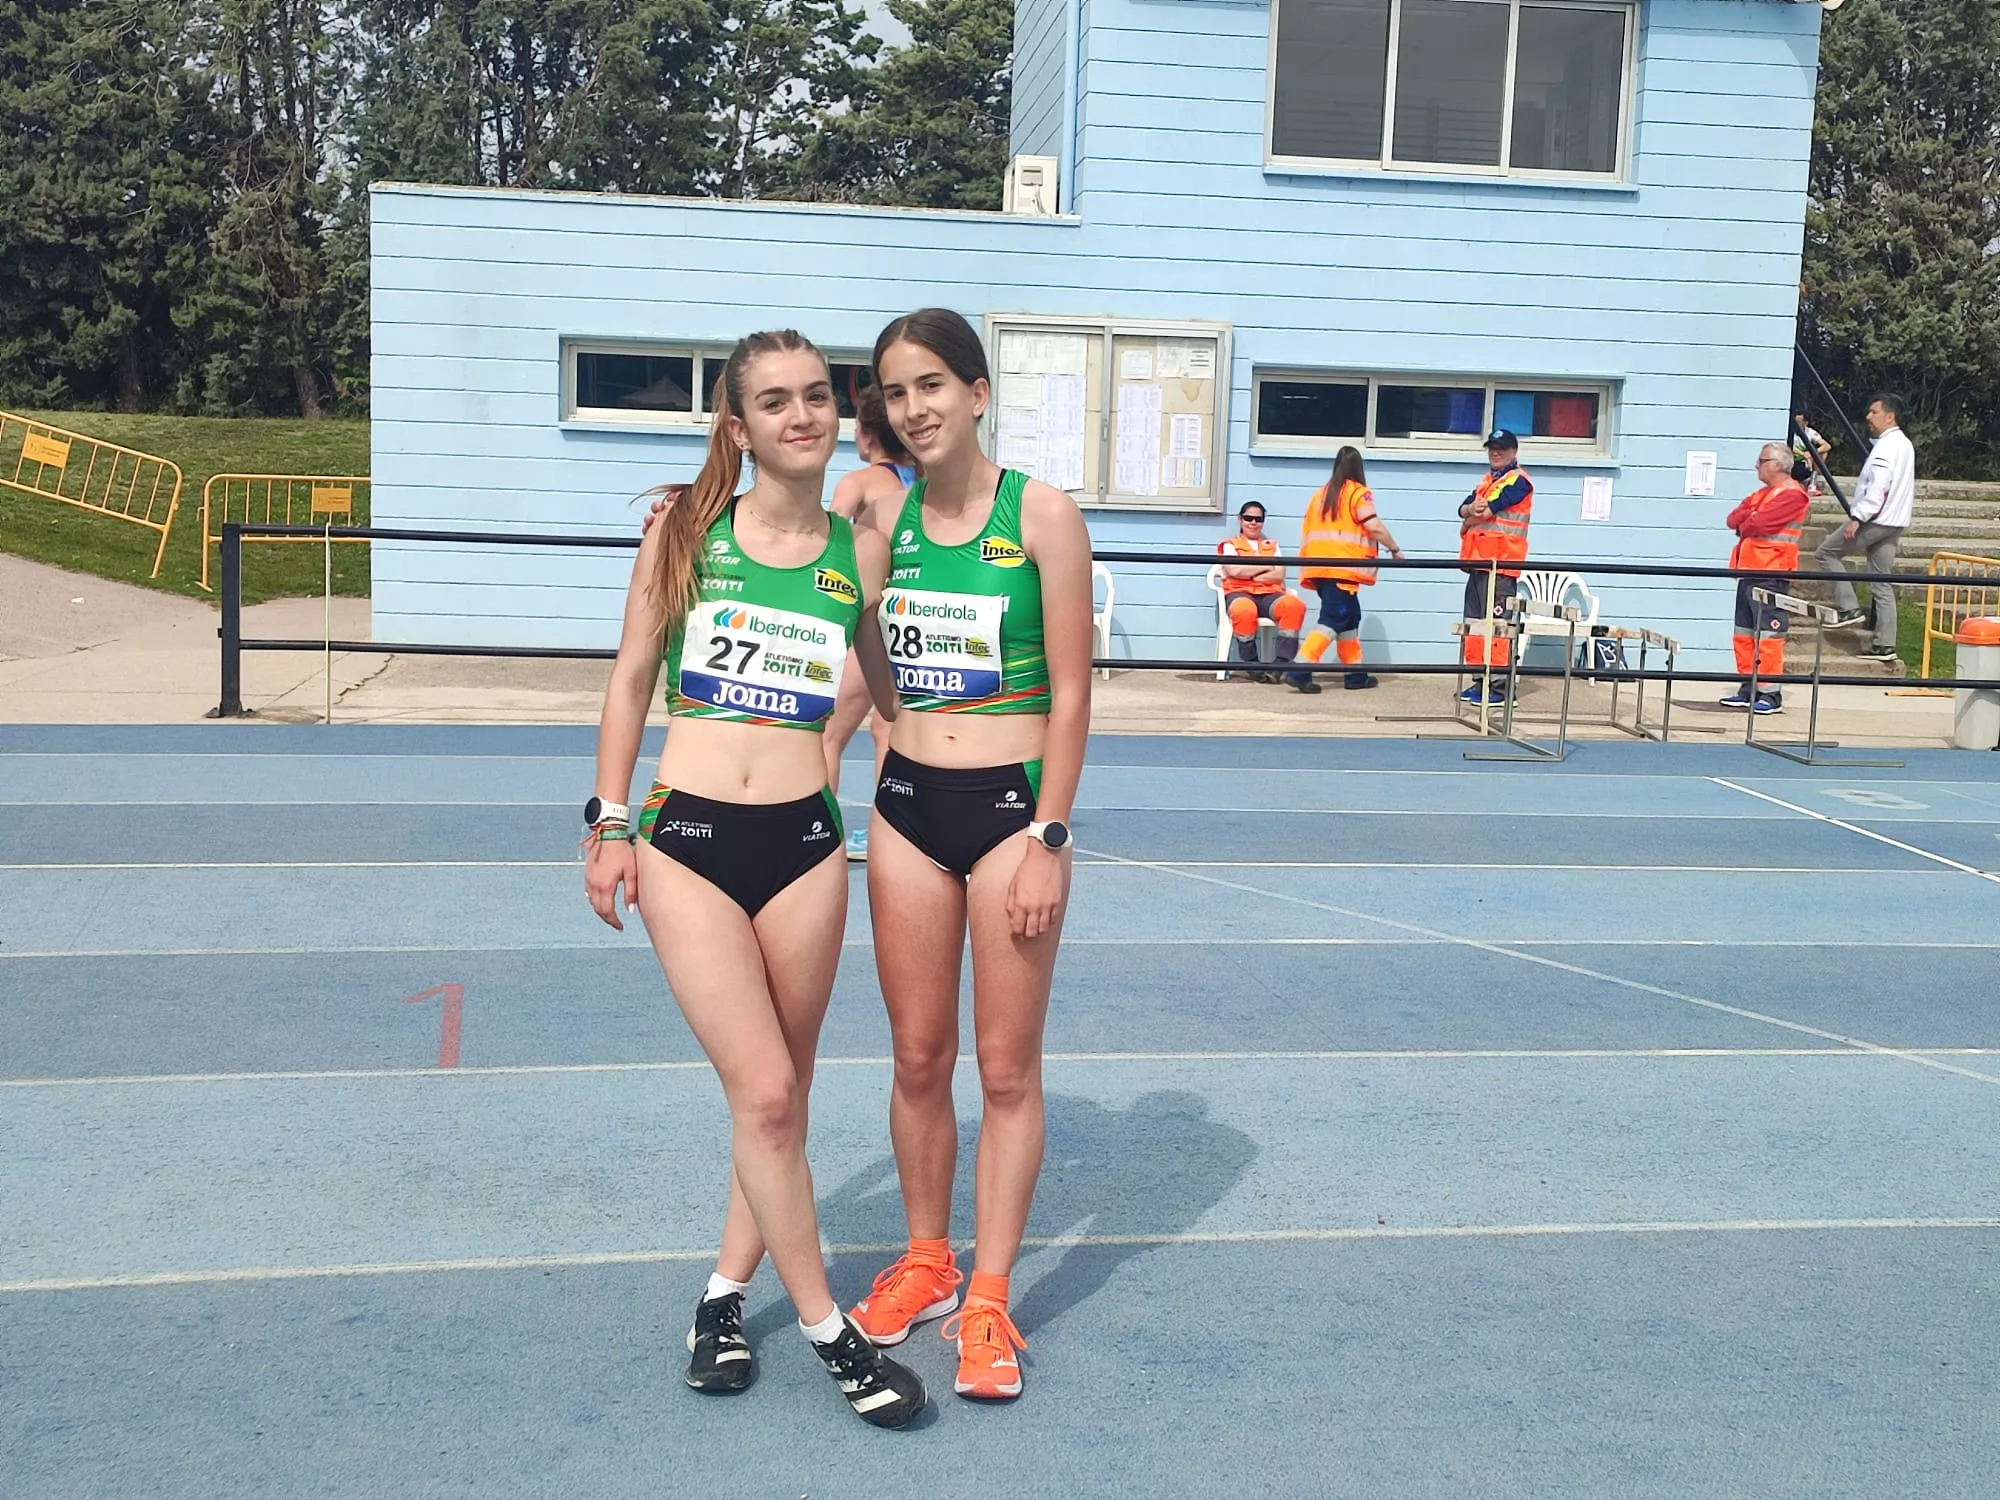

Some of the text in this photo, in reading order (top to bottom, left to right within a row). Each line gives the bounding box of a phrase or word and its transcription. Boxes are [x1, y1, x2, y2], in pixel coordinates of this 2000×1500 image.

[705, 554, 741, 565] ATOR
[702, 579, 744, 592] ZOITI
[816, 569, 857, 598] Intec
[909, 601, 977, 621] Iberdrola
[749, 616, 827, 645] Iberdrola
[888, 623, 923, 659] 28
[926, 641, 962, 654] ZOITI
[706, 636, 761, 675] 27
[764, 652, 804, 664] ATLETISMO
[762, 660, 802, 677] ZOITI
[804, 661, 834, 681] Intec
[680, 826, 713, 838] ZOITI
[402, 982, 464, 1069] 1
